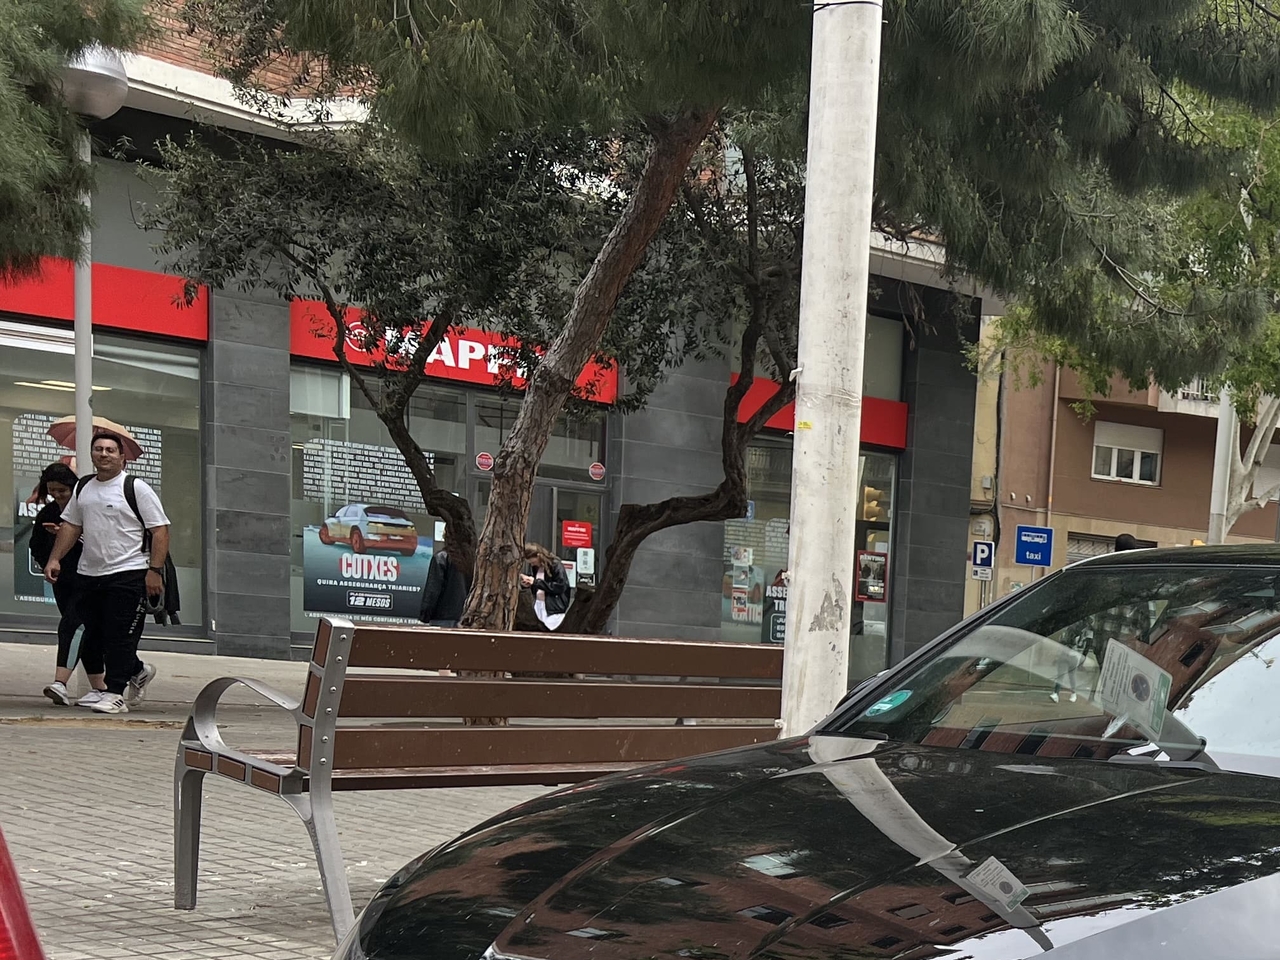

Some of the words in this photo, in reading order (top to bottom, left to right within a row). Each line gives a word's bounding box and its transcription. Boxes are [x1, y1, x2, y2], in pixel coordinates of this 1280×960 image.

[975, 543, 989, 565] P
[1025, 550, 1042, 560] taxi
[341, 552, 398, 582] COTXES
[316, 578, 338, 587] QUINA
[338, 579, 387, 591] ASSEGURANÇA
[349, 596, 366, 606] 12
[365, 597, 391, 608] MESOS
